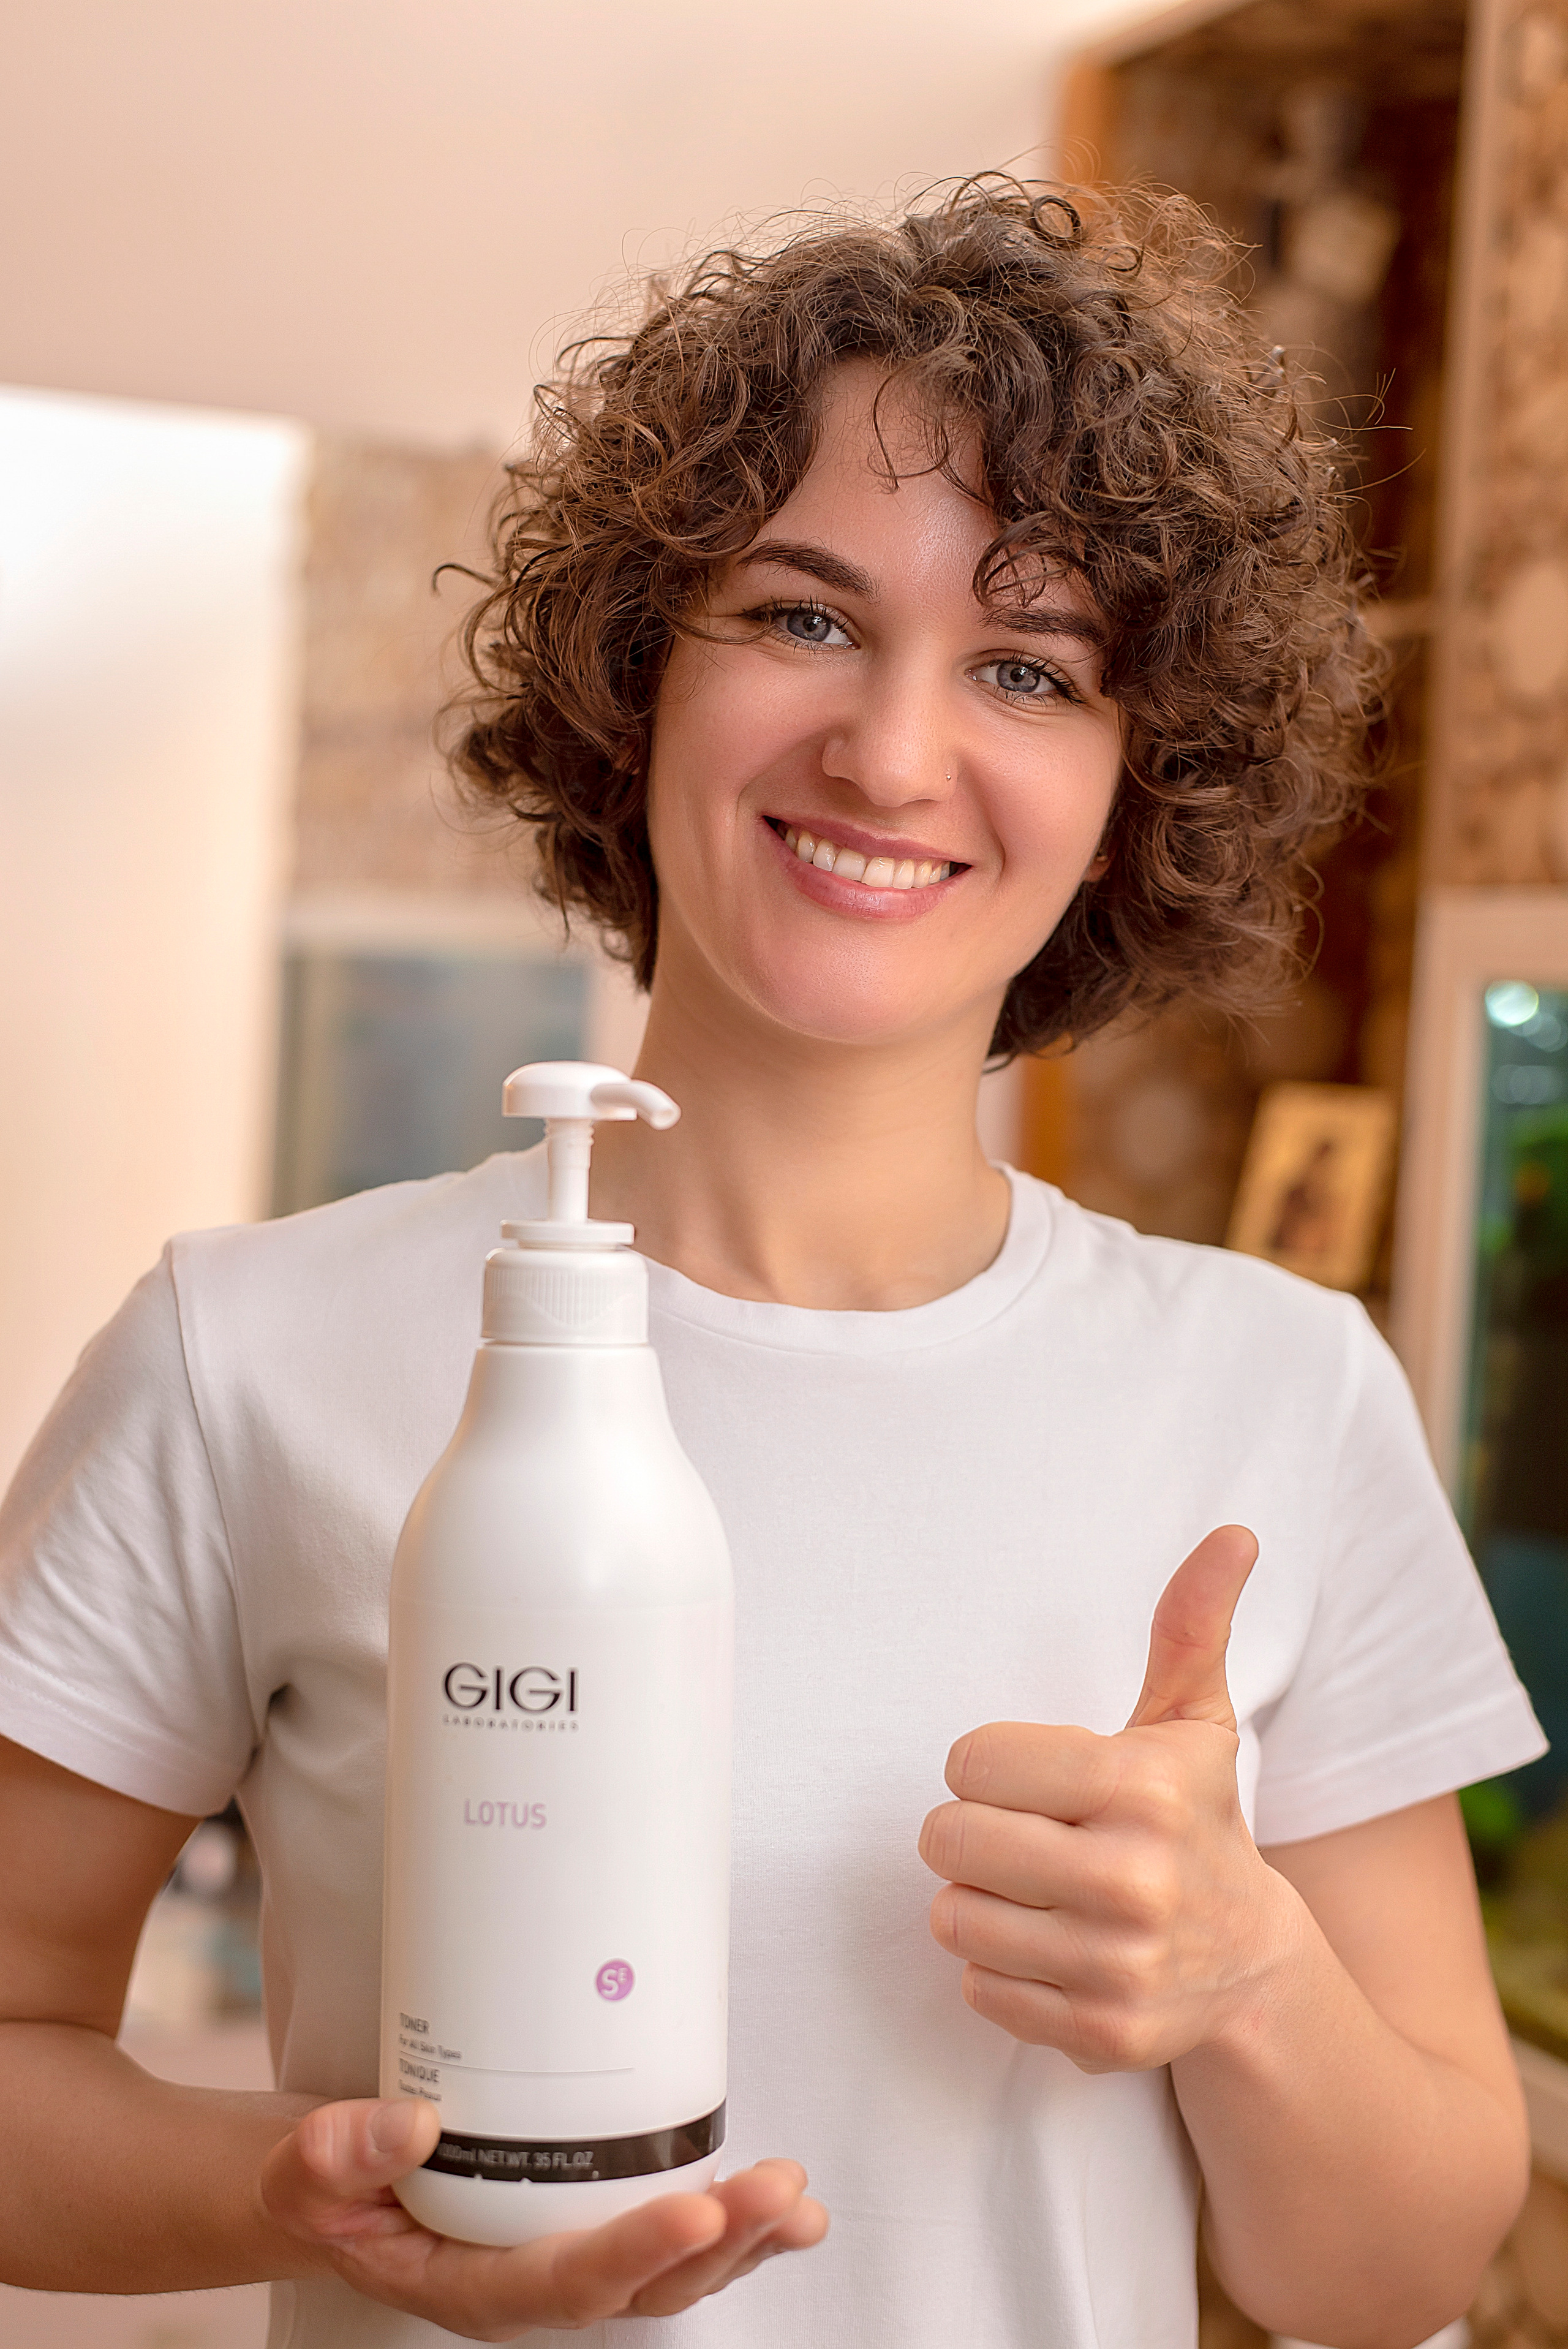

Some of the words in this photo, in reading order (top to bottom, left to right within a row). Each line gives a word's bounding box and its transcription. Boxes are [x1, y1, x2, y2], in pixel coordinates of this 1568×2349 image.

[444, 1663, 575, 1711] GIGI
[464, 1800, 547, 1828] LOTUS
[400, 2012, 429, 2033] TONER
[399, 2057, 440, 2083] TONIQUE
[532, 2152, 551, 2168] 35
